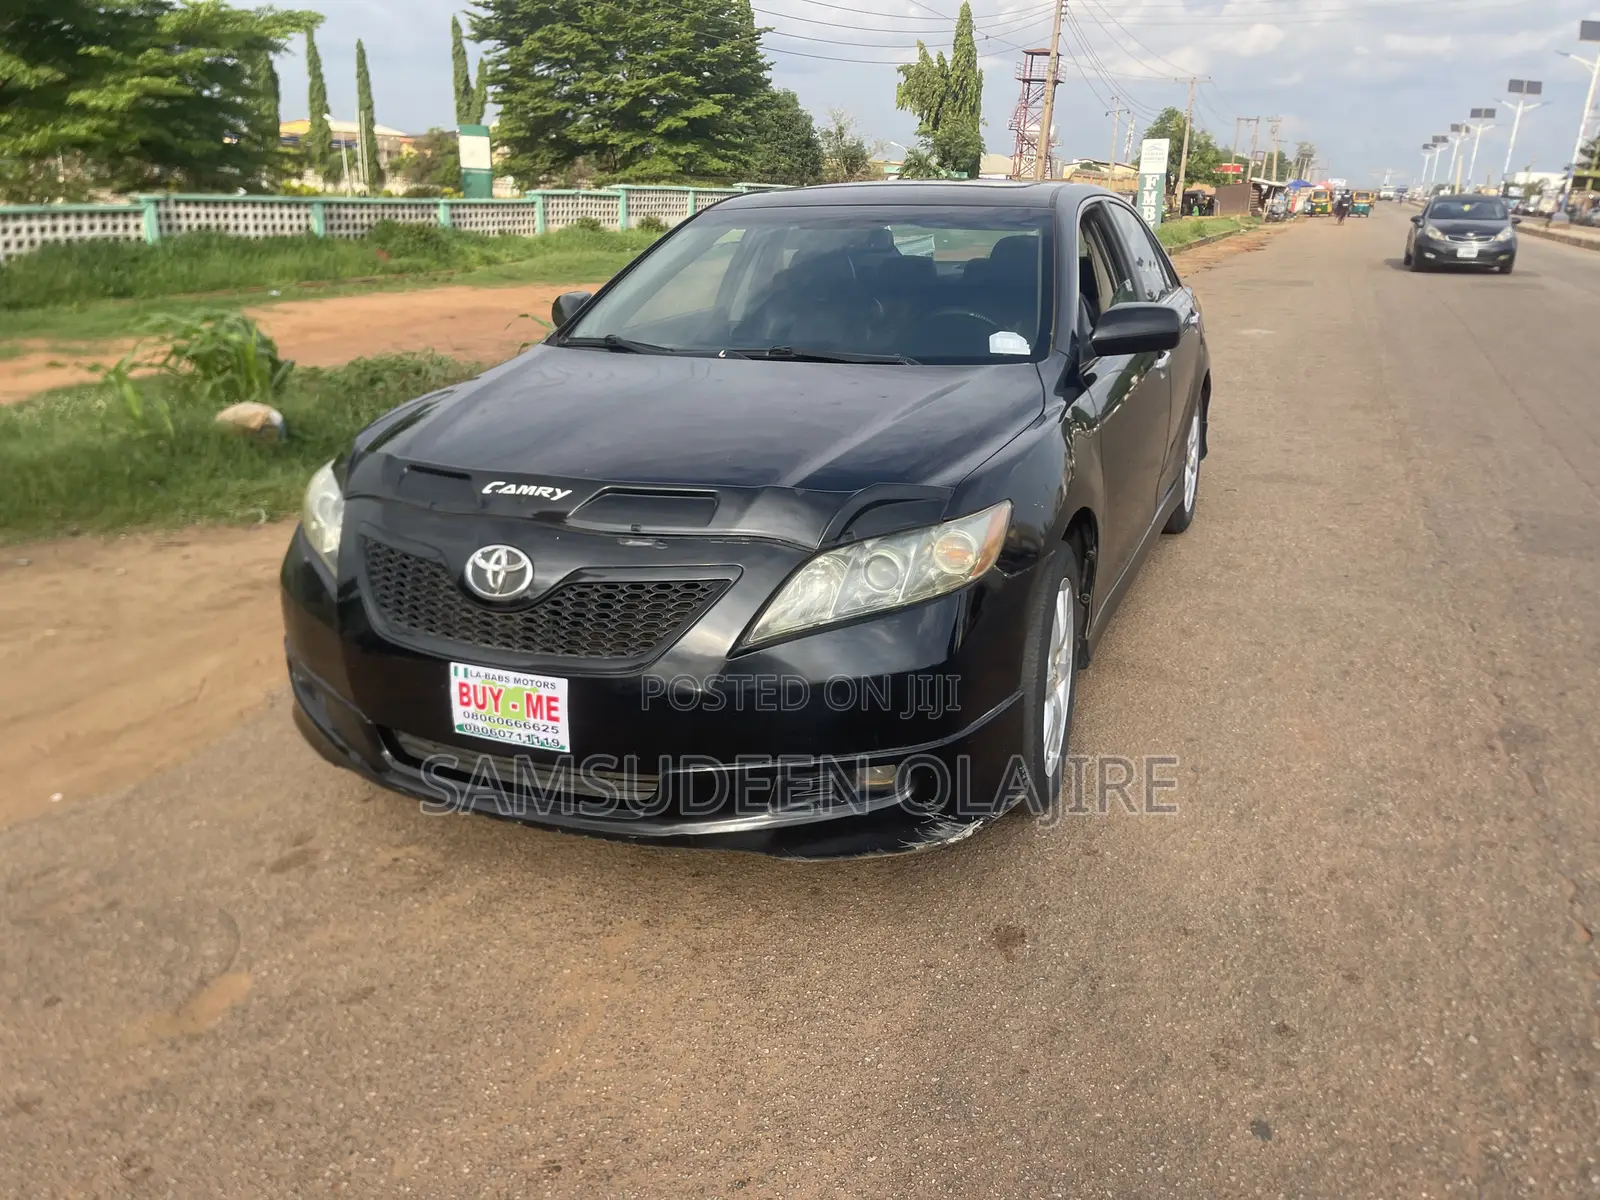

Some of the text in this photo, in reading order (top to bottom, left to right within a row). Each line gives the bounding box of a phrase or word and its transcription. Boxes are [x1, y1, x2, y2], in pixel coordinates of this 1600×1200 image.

[482, 481, 573, 501] CAMRY
[470, 670, 556, 690] LA-BABS MOTORS
[458, 681, 503, 713] BUY
[525, 692, 560, 723] ME
[463, 712, 559, 735] 08060666625
